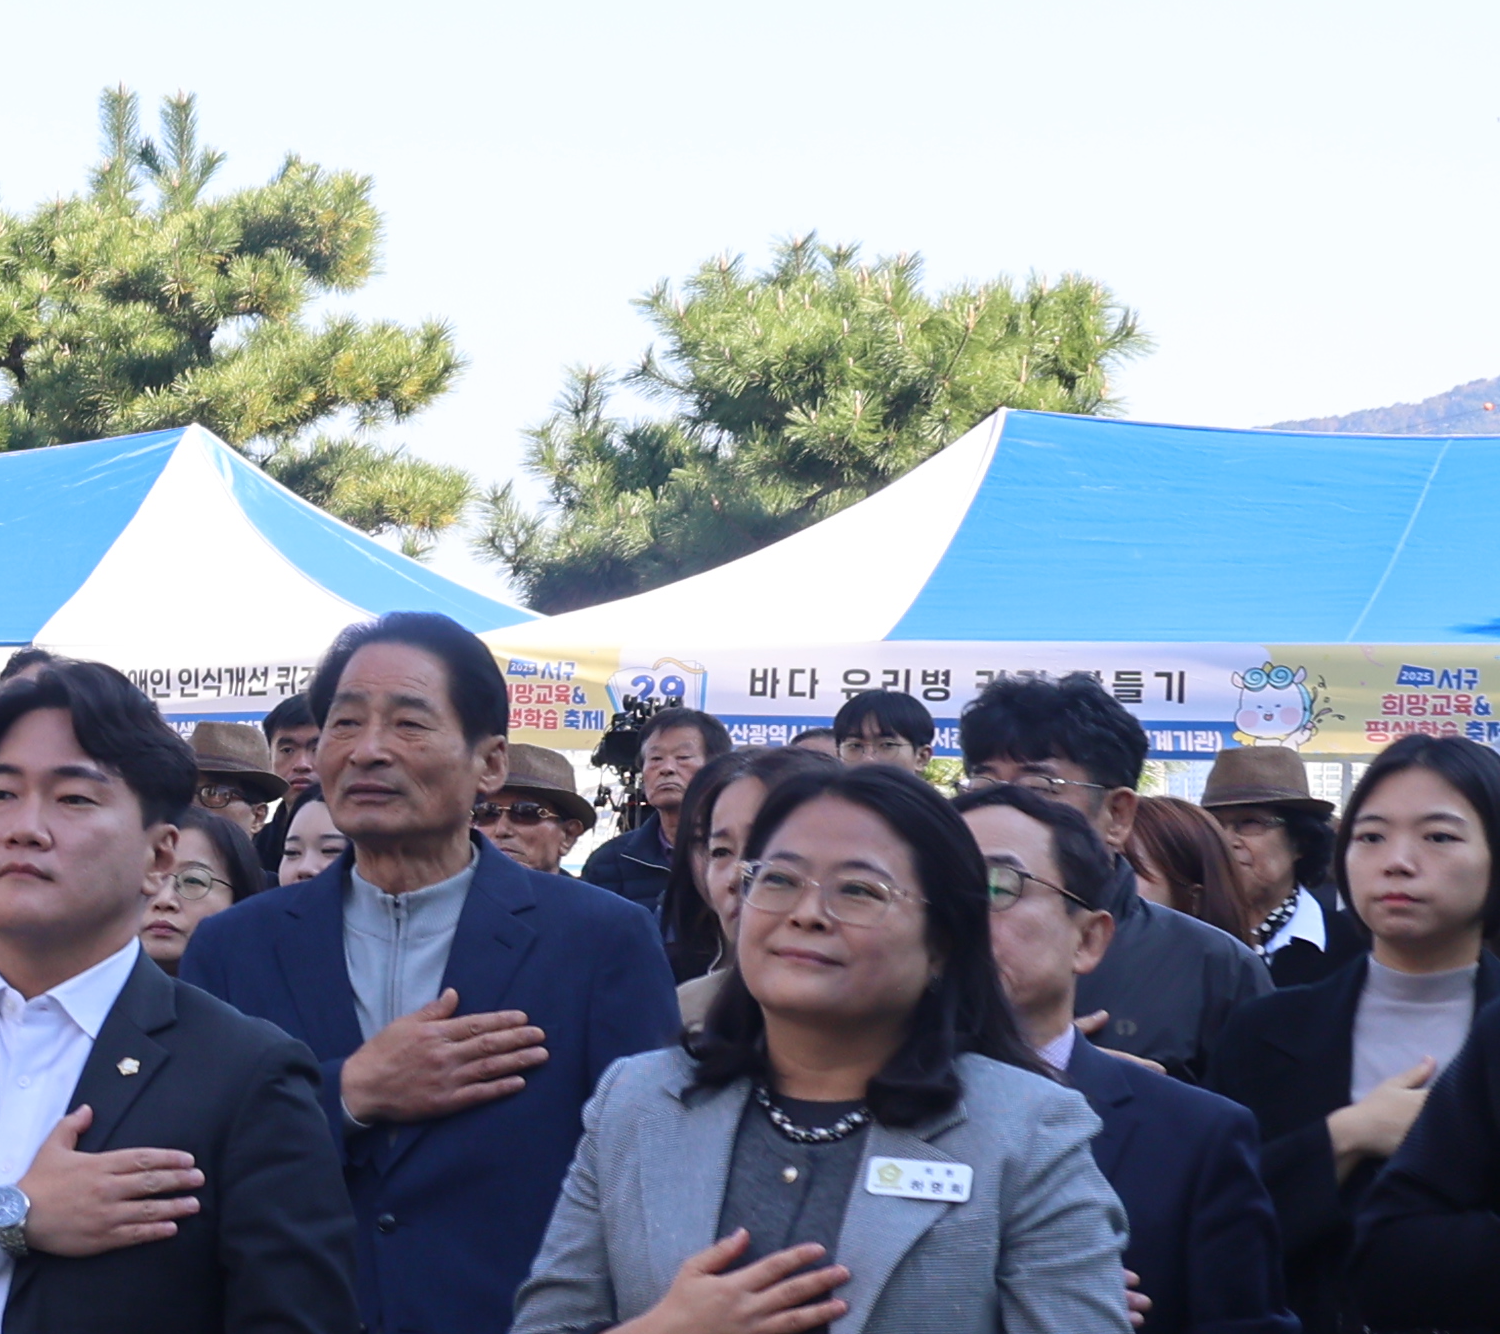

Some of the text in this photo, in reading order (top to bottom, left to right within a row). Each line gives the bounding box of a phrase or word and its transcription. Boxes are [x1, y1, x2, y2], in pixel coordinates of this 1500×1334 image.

[510, 661, 575, 680] 2025 서구
[1401, 669, 1478, 690] 2025 서구
[121, 668, 171, 698] 애인
[178, 666, 269, 698] 인식개선
[631, 675, 685, 701] 29
[749, 667, 819, 700] 바다
[840, 668, 951, 702] 유리병
[1101, 670, 1185, 704] 들기
[508, 684, 587, 705] 망교육&
[1382, 693, 1491, 716] 희망교육&
[564, 709, 604, 730] 축제
[1148, 730, 1223, 752] 계기관)
